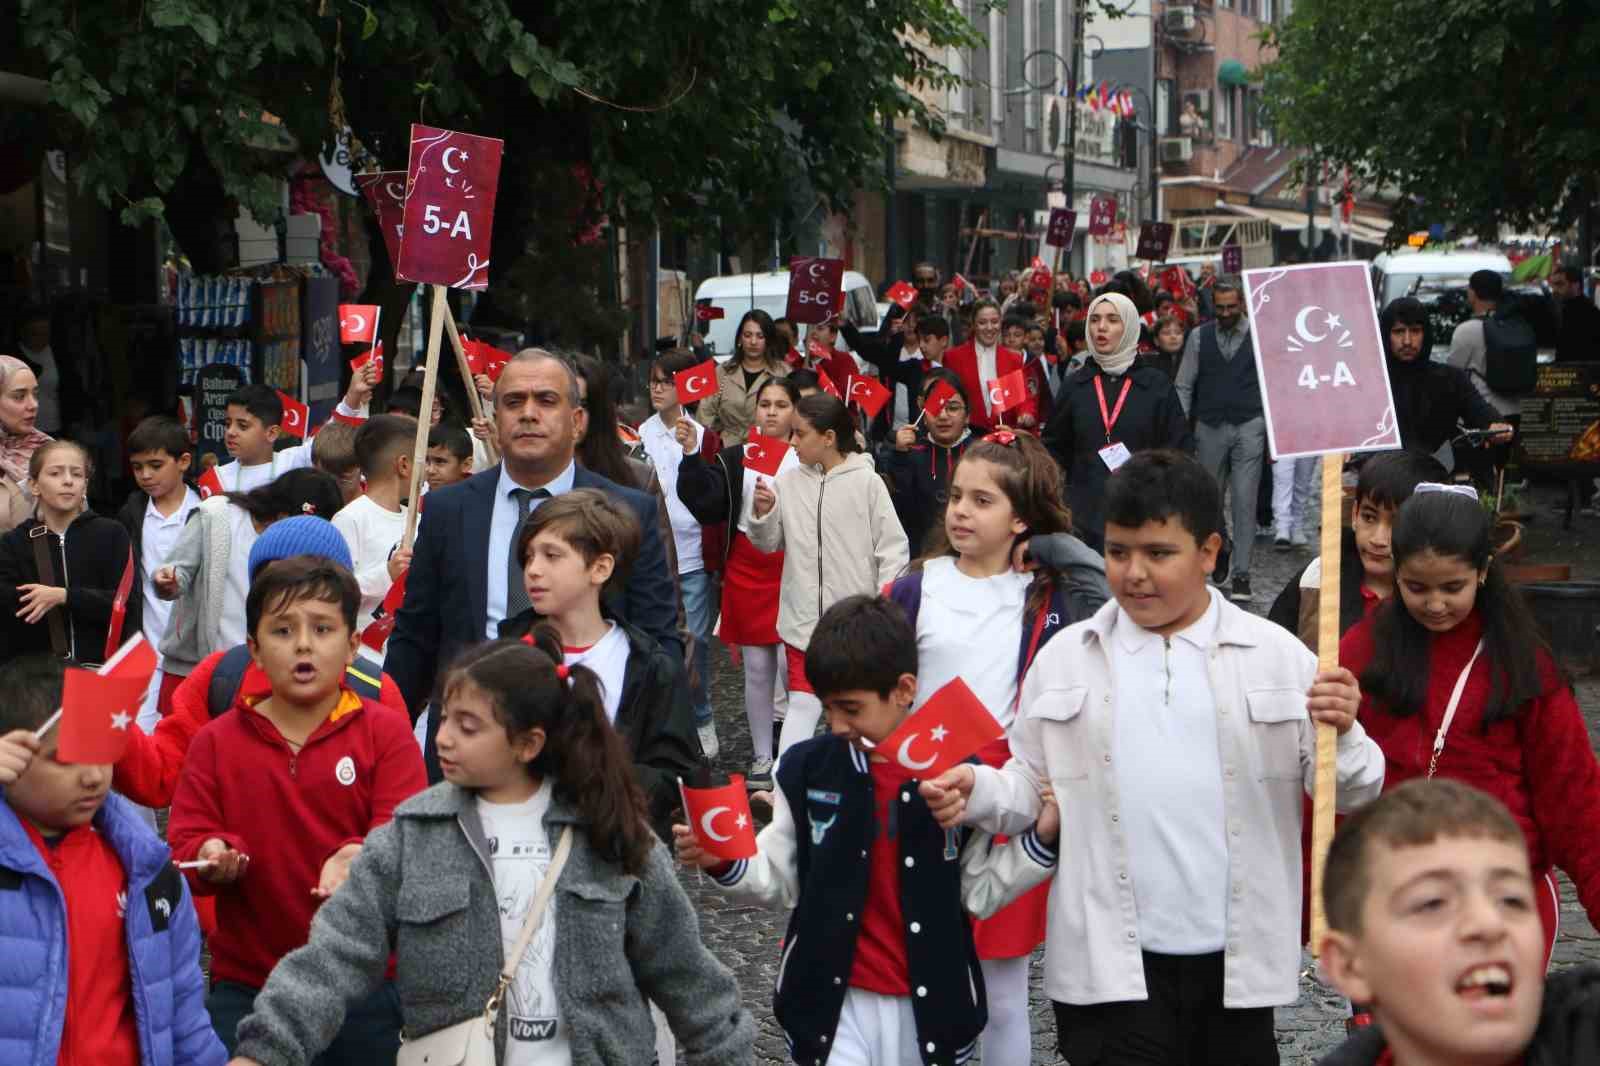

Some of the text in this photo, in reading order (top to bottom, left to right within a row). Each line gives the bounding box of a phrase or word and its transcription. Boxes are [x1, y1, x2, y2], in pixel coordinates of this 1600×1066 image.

[423, 204, 472, 240] 5-A
[799, 290, 830, 306] 5-C
[1297, 361, 1357, 390] 4-A
